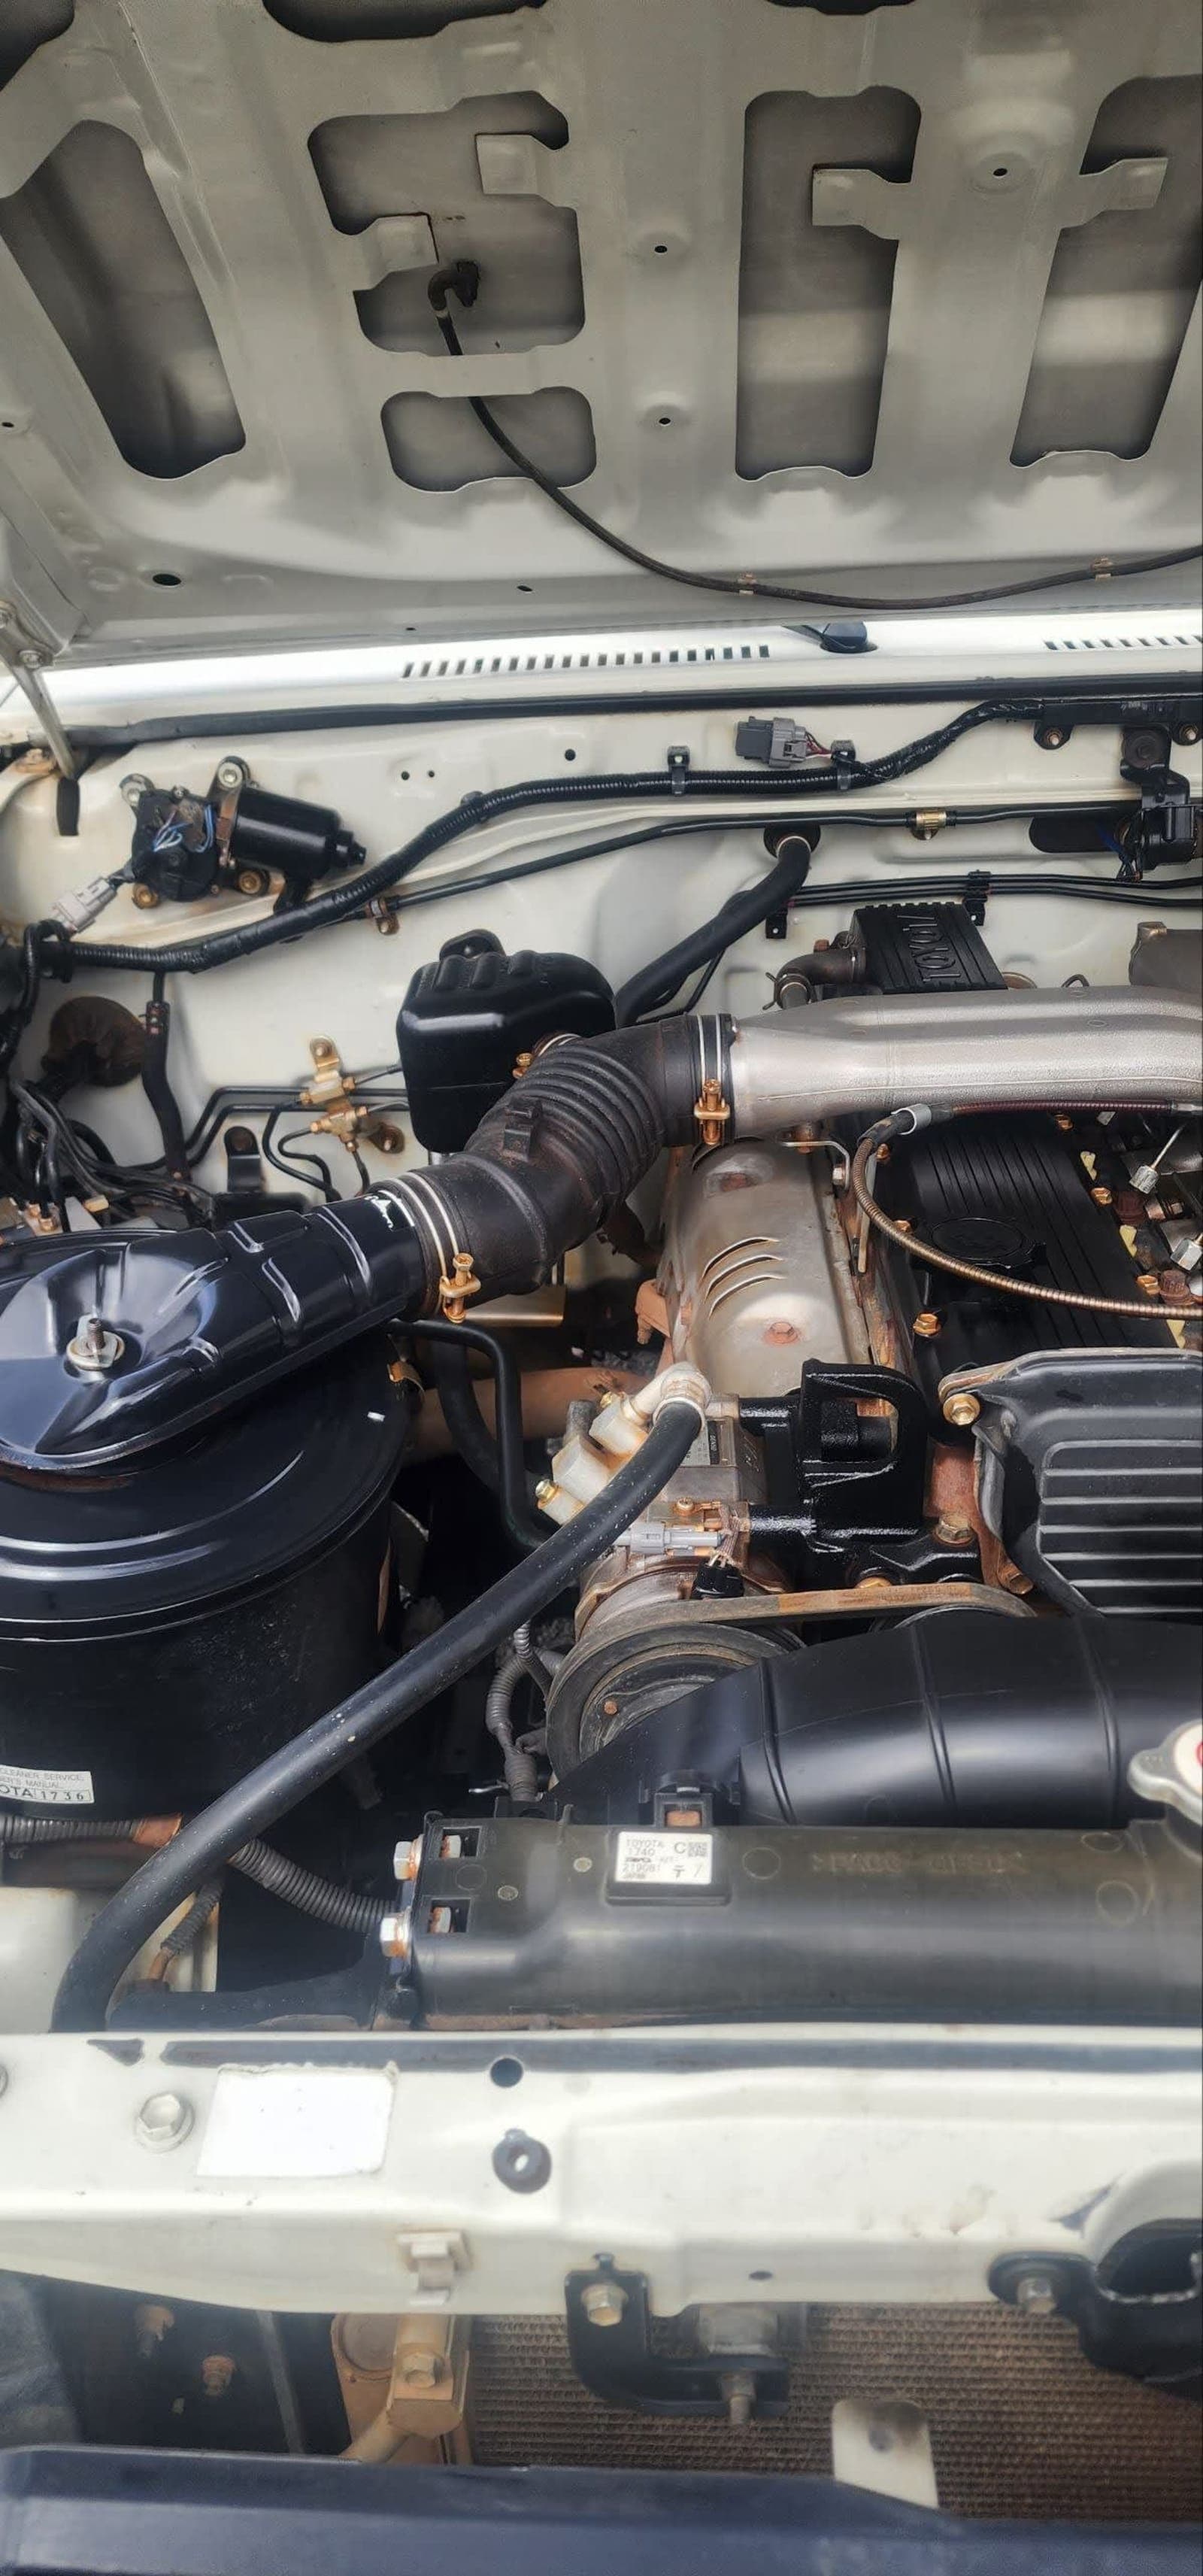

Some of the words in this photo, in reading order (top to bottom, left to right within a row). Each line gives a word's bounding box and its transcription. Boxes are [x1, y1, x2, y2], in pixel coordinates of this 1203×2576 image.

[41, 1791, 84, 1800] 1736
[626, 1839, 665, 1848] TOYOTA
[674, 1842, 686, 1854] C
